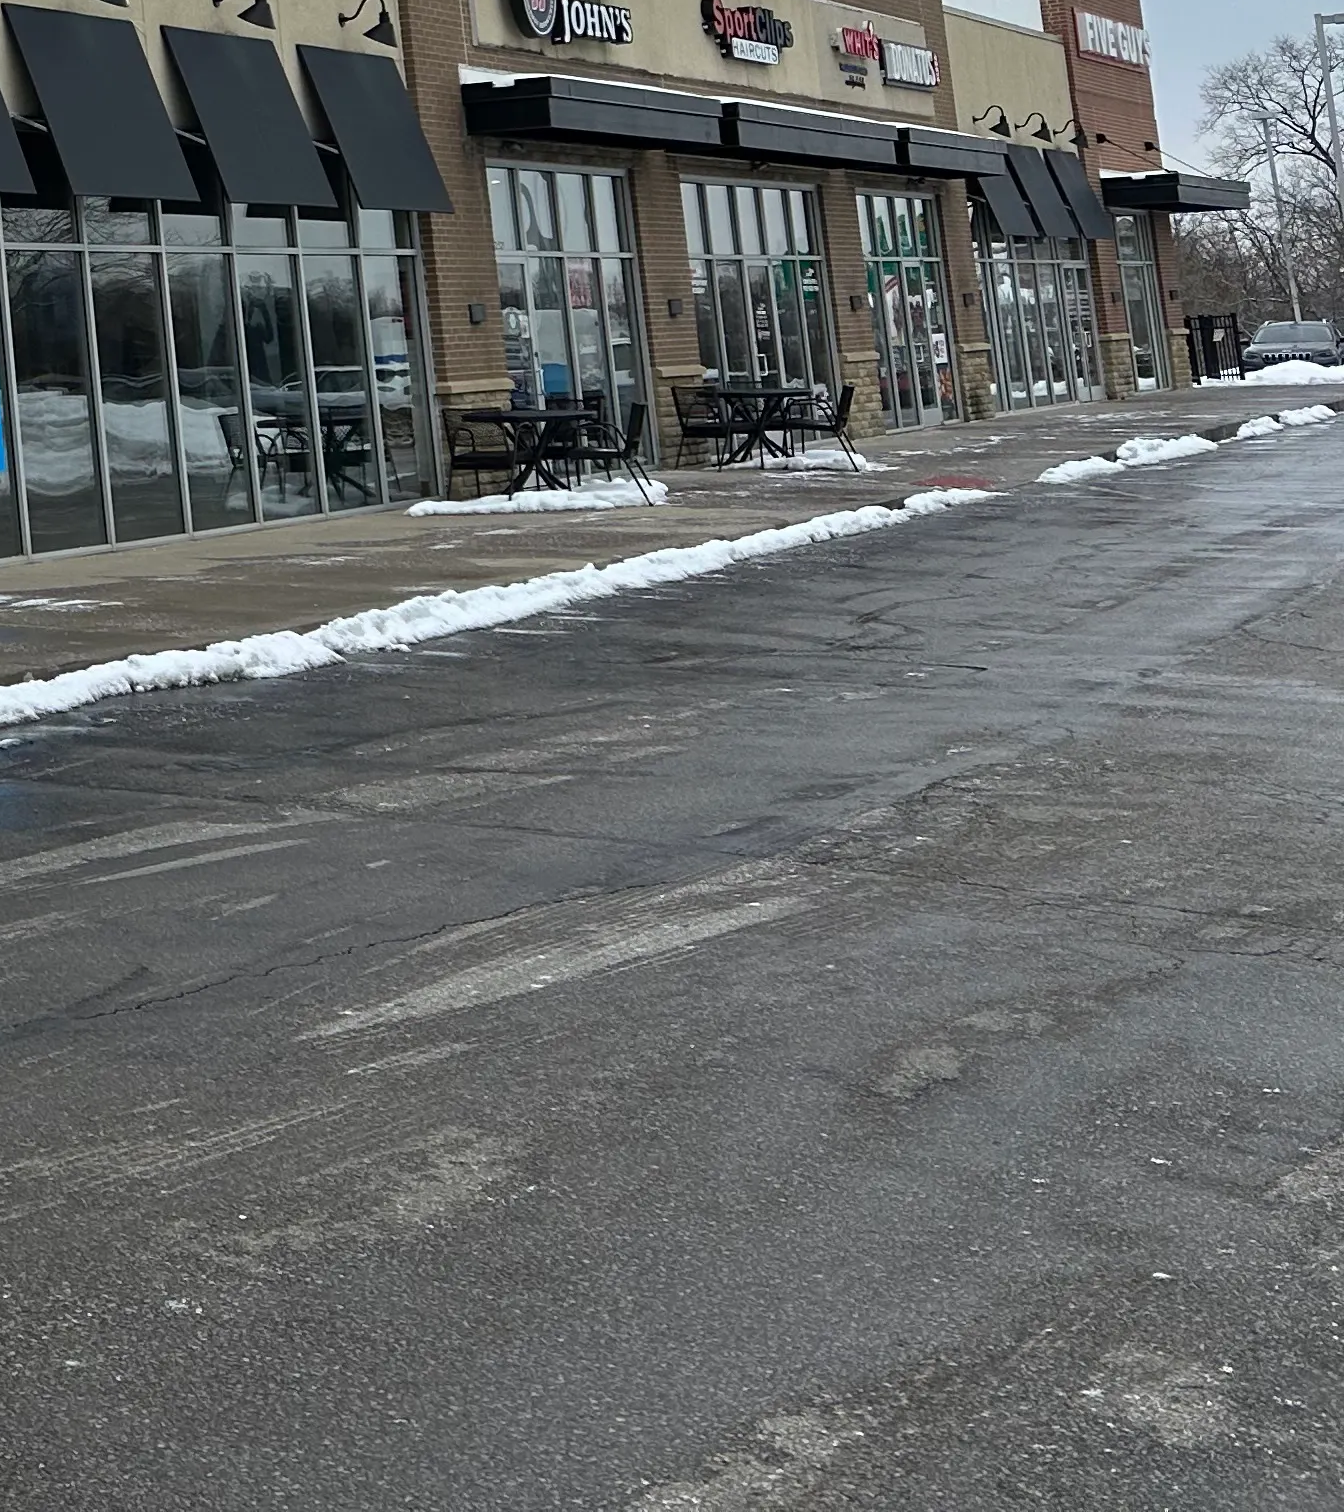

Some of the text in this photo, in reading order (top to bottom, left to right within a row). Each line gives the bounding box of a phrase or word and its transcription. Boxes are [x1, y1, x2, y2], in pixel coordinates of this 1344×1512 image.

[733, 40, 778, 62] HAIRCUTS
[1083, 12, 1152, 66] FIVE GUYS
